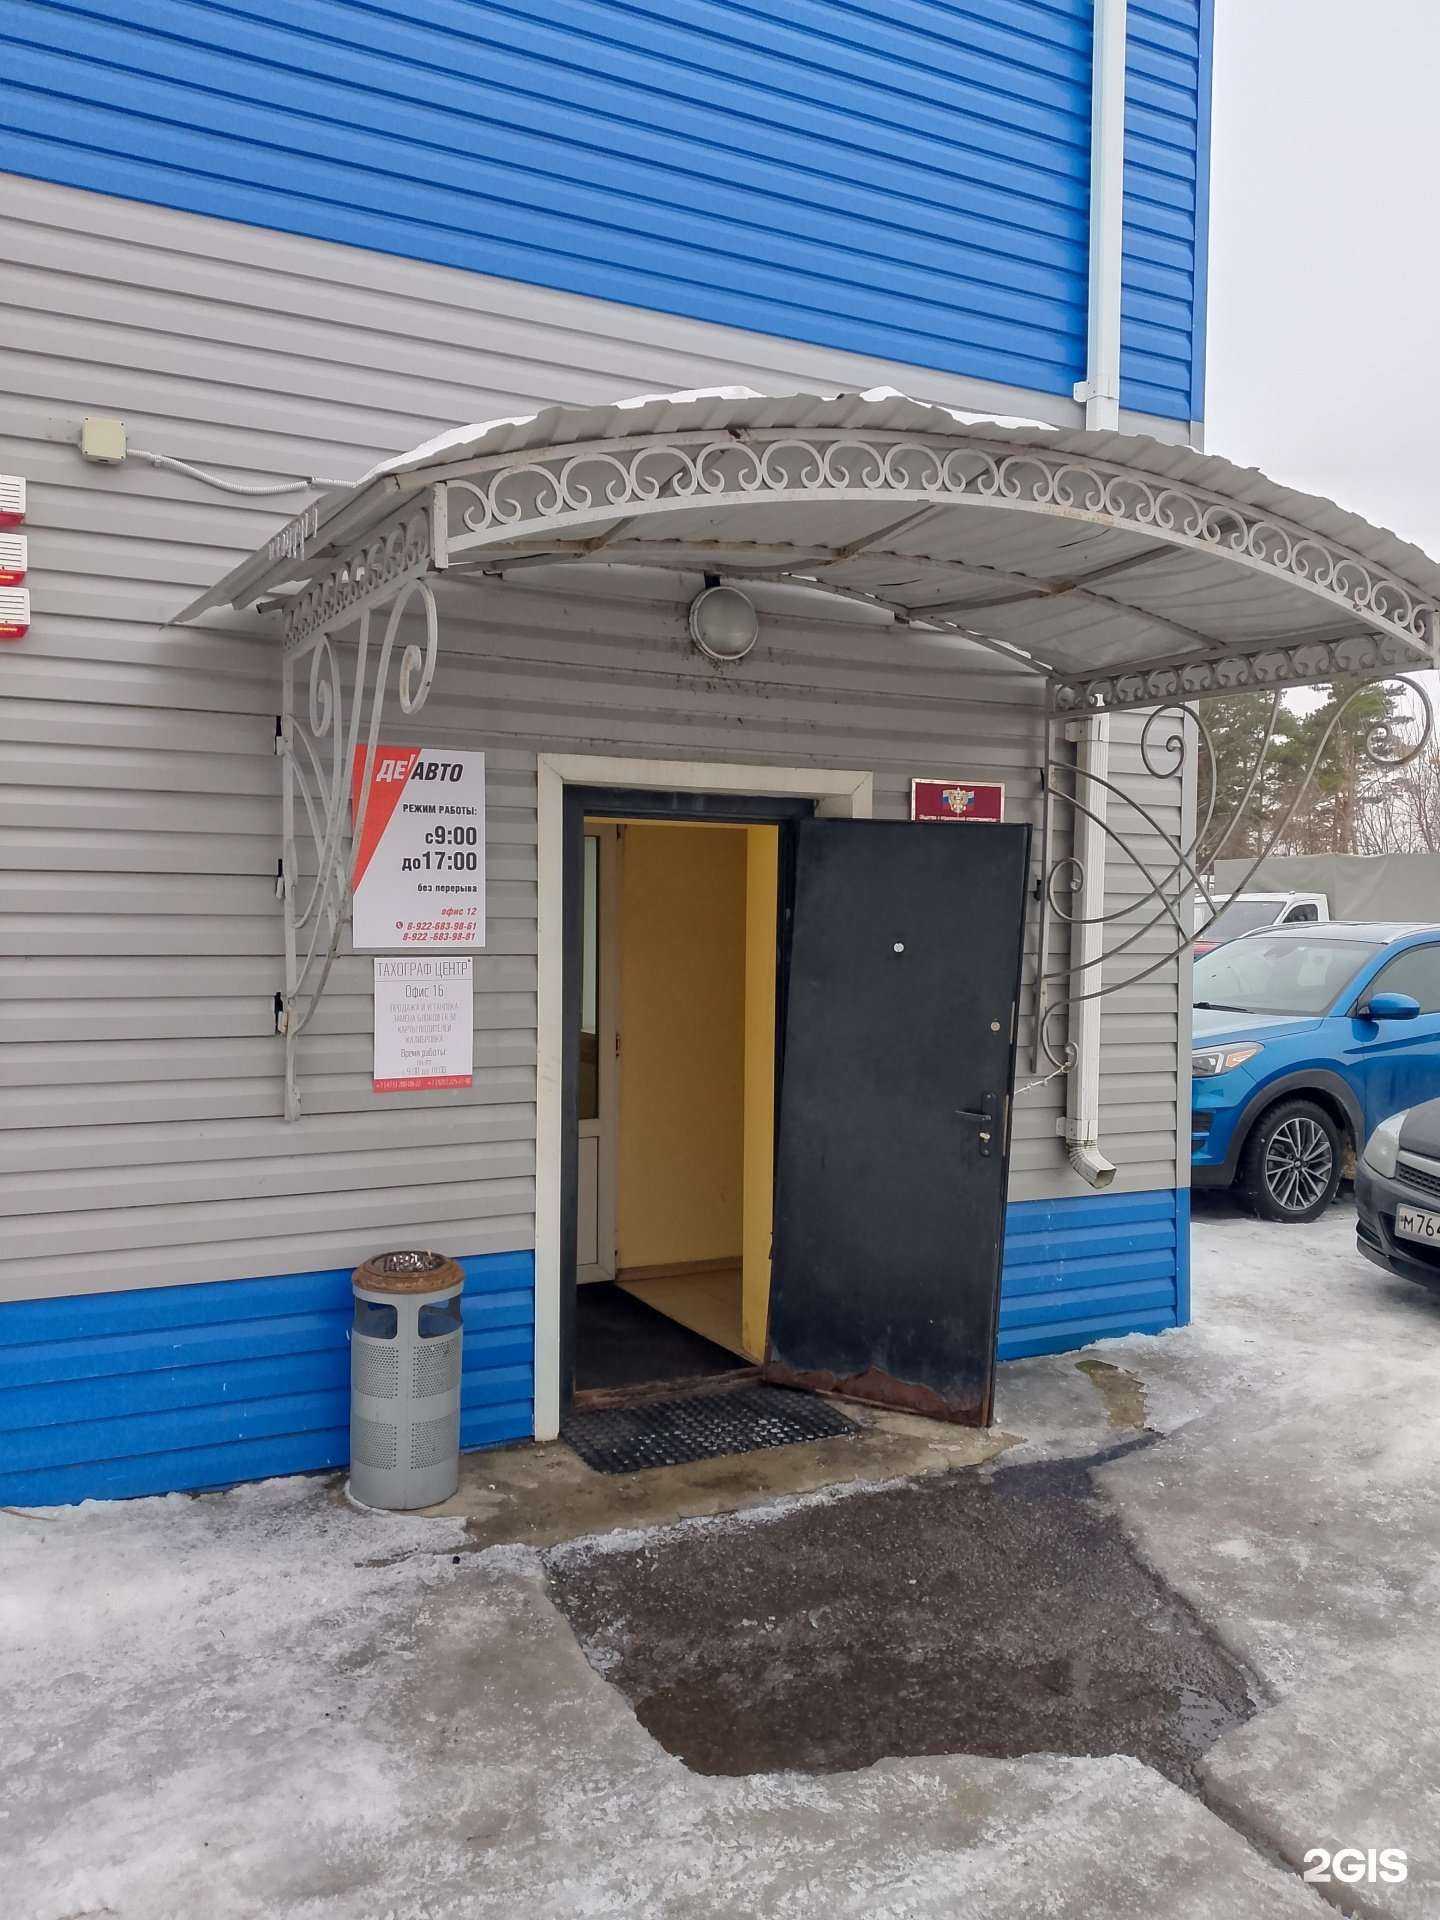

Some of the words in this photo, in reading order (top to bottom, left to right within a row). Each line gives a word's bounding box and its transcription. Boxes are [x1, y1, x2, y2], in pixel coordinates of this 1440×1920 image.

[403, 804, 437, 814] РЕЖИМ
[439, 805, 478, 816] РАБОТЫ:
[417, 884, 433, 893] без
[435, 885, 478, 896] перерыва
[441, 906, 464, 917] офис
[466, 907, 477, 916] 12
[376, 962, 432, 977] ТАХОГРАФ
[435, 962, 468, 978] ЦЕНТР
[405, 984, 430, 998] Офис
